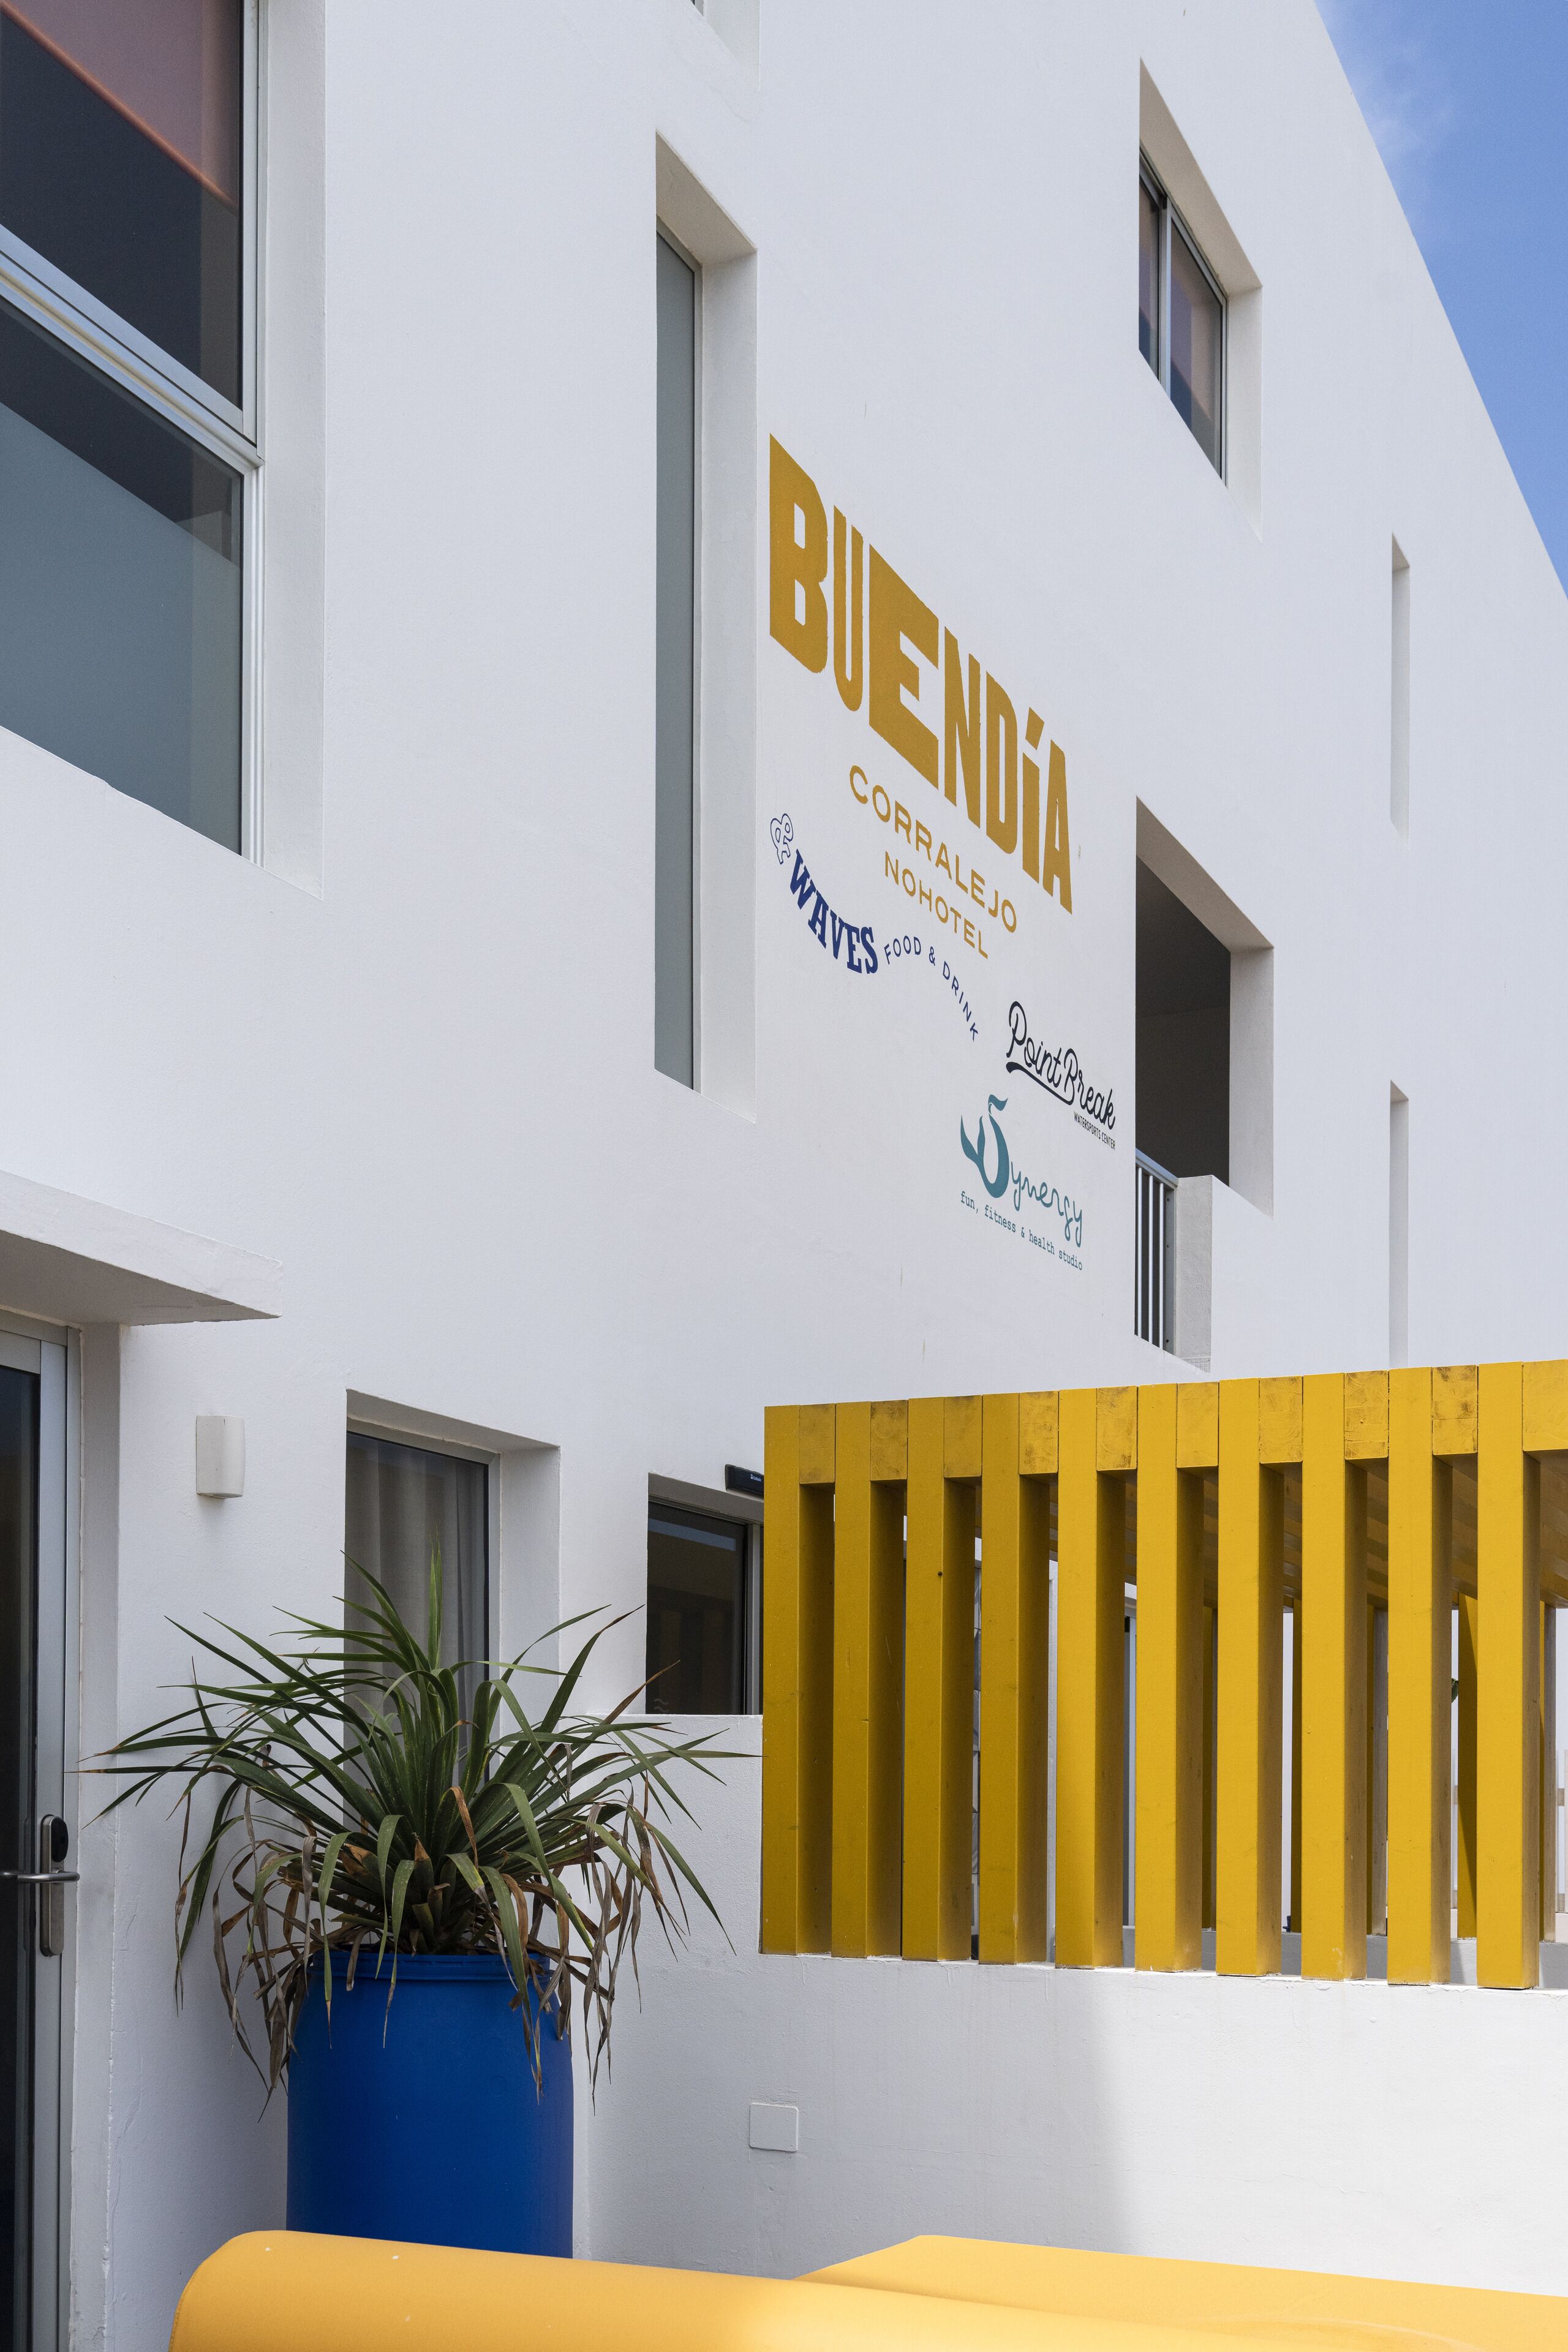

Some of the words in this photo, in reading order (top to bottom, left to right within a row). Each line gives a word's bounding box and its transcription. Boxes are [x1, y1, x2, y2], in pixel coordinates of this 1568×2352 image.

[849, 764, 1017, 933] CORRALEJO
[790, 848, 878, 974] WAVES
[885, 850, 988, 959] NOHOTEL
[883, 935, 922, 965] FOOD
[929, 946, 936, 966] &
[942, 961, 979, 1041] DRINK
[1074, 1111, 1101, 1140] WATERSPORTS
[1101, 1132, 1116, 1150] CENTER
[960, 1190, 979, 1214] fun,
[984, 1204, 1016, 1233] fitness
[1021, 1227, 1025, 1238] &
[1029, 1230, 1055, 1255] health
[1058, 1250, 1082, 1271] studio
